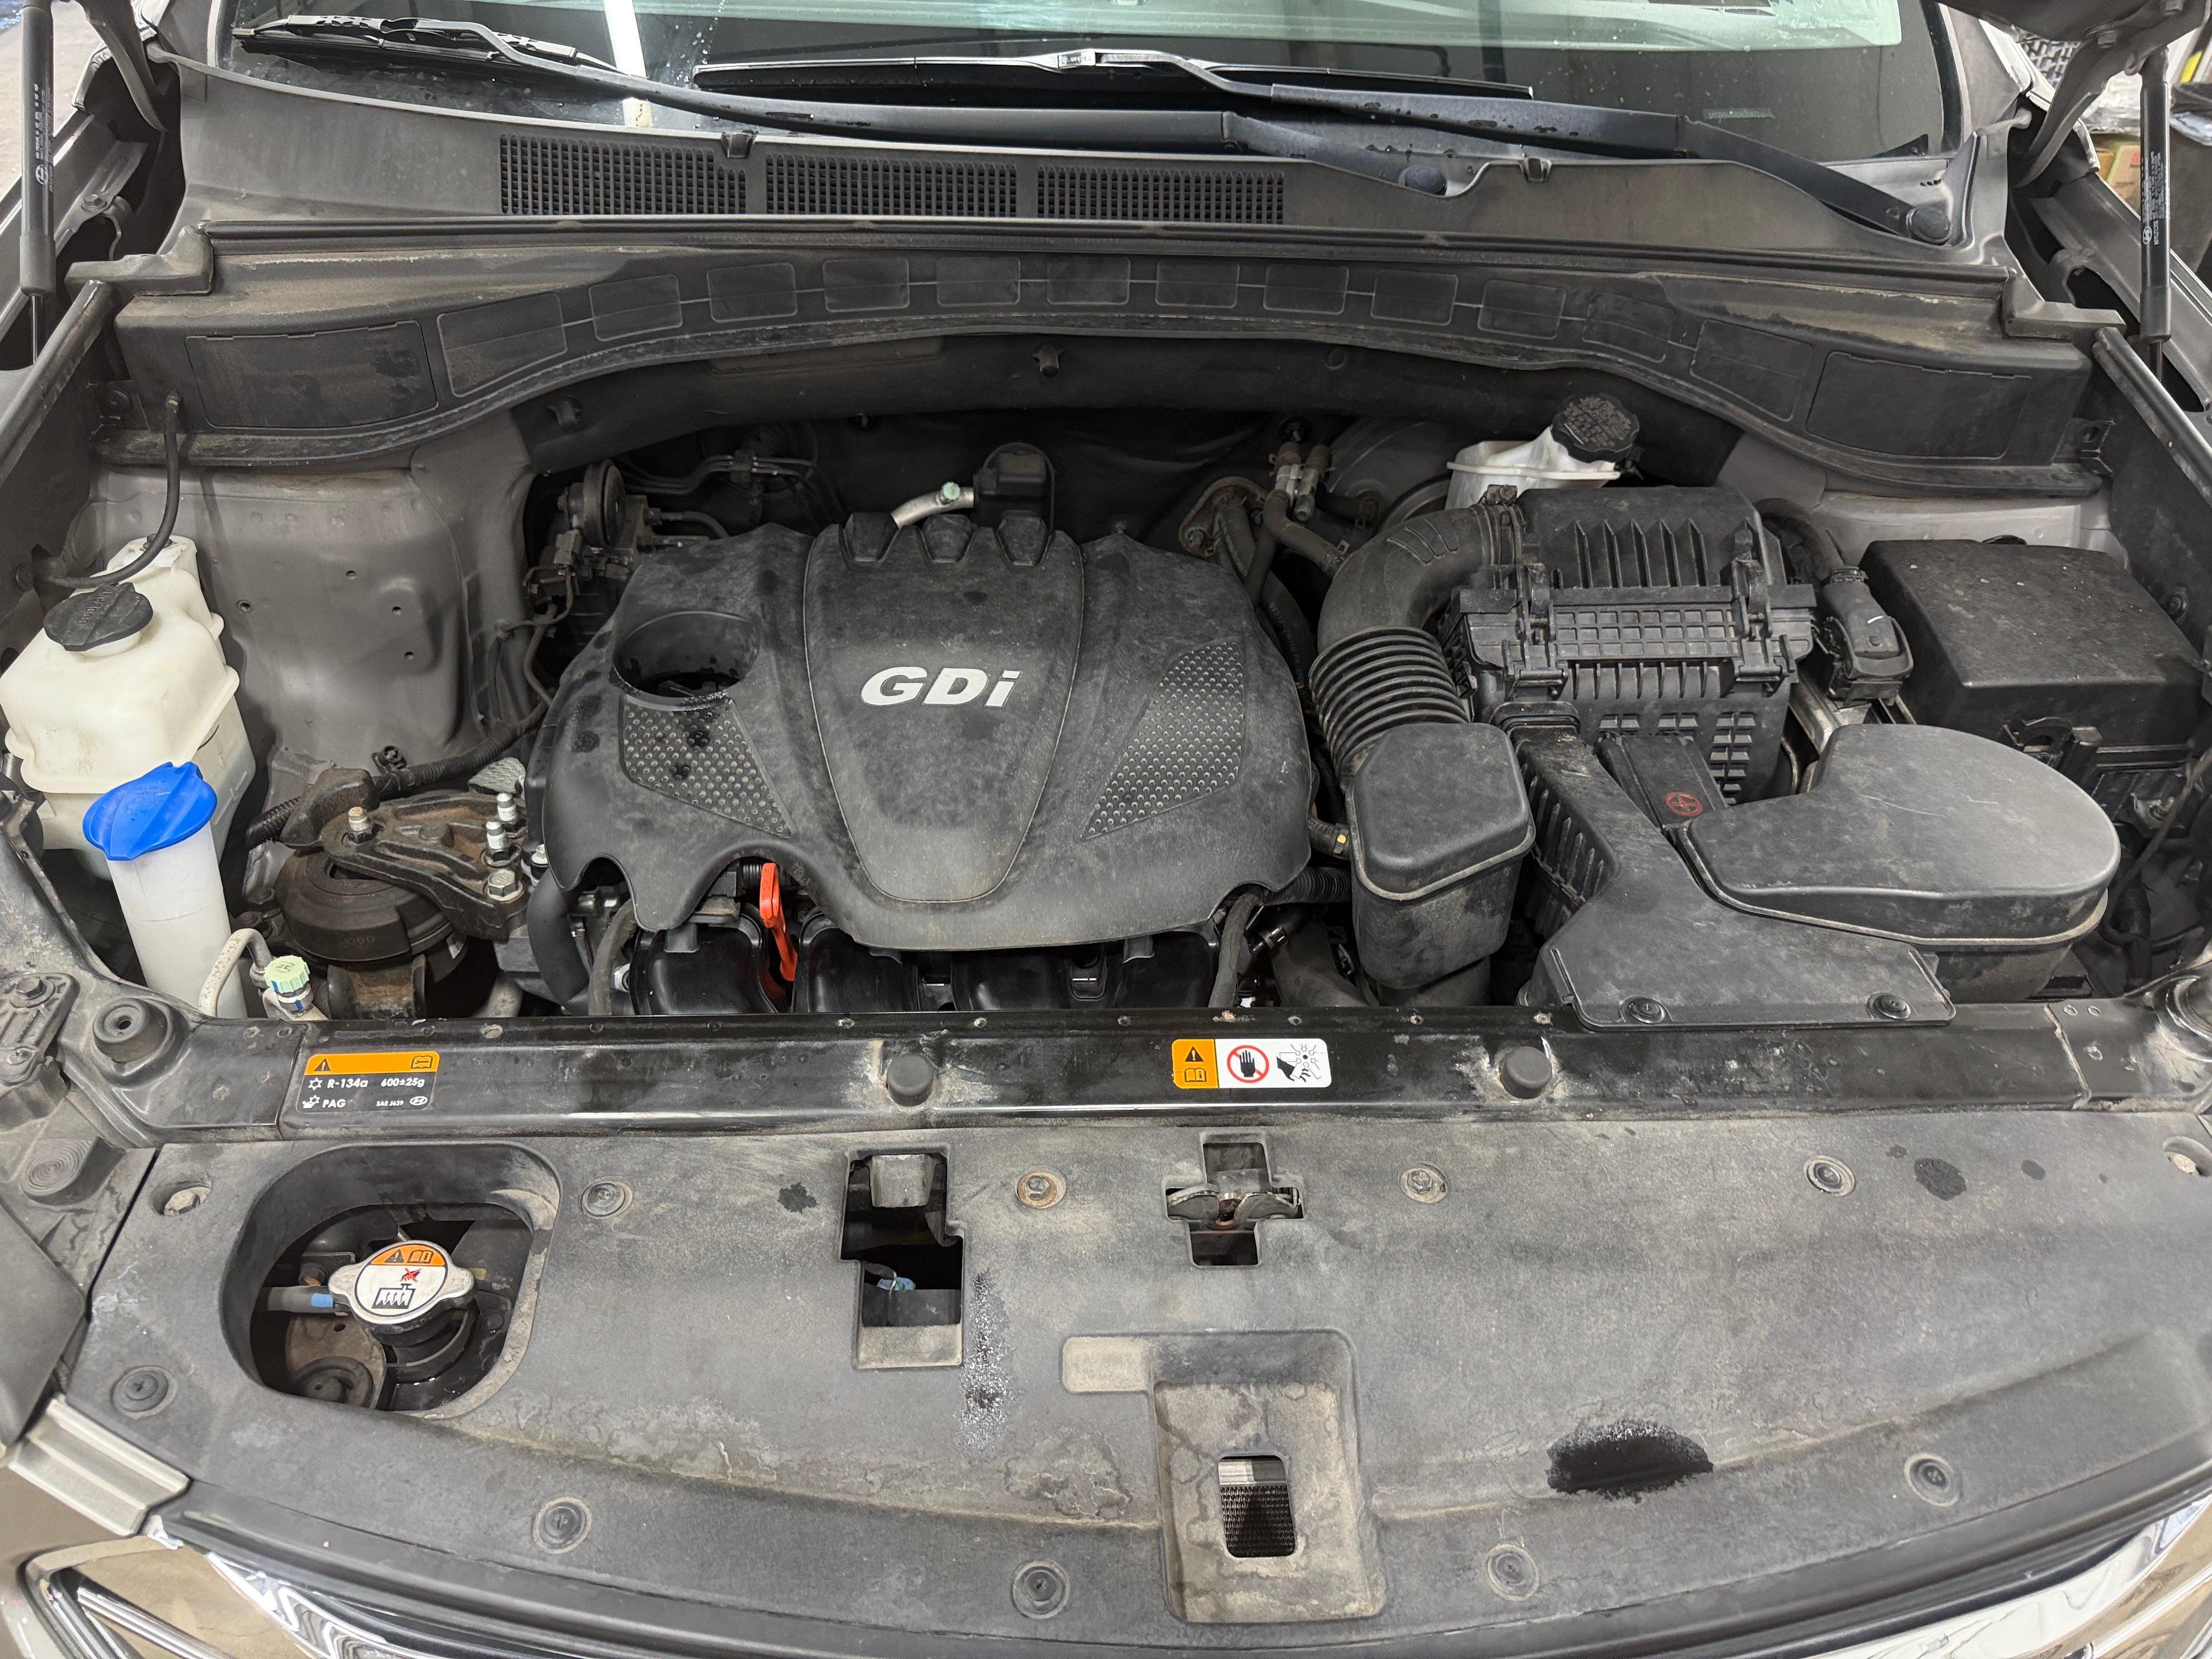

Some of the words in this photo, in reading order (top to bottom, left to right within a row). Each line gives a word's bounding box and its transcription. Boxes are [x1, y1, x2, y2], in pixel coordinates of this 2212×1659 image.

[77, 589, 114, 624] COOLANT
[861, 667, 1022, 708] GDi
[327, 1078, 369, 1088] R-134a
[380, 1077, 426, 1088] 600±25g
[322, 1099, 346, 1108] PAG
